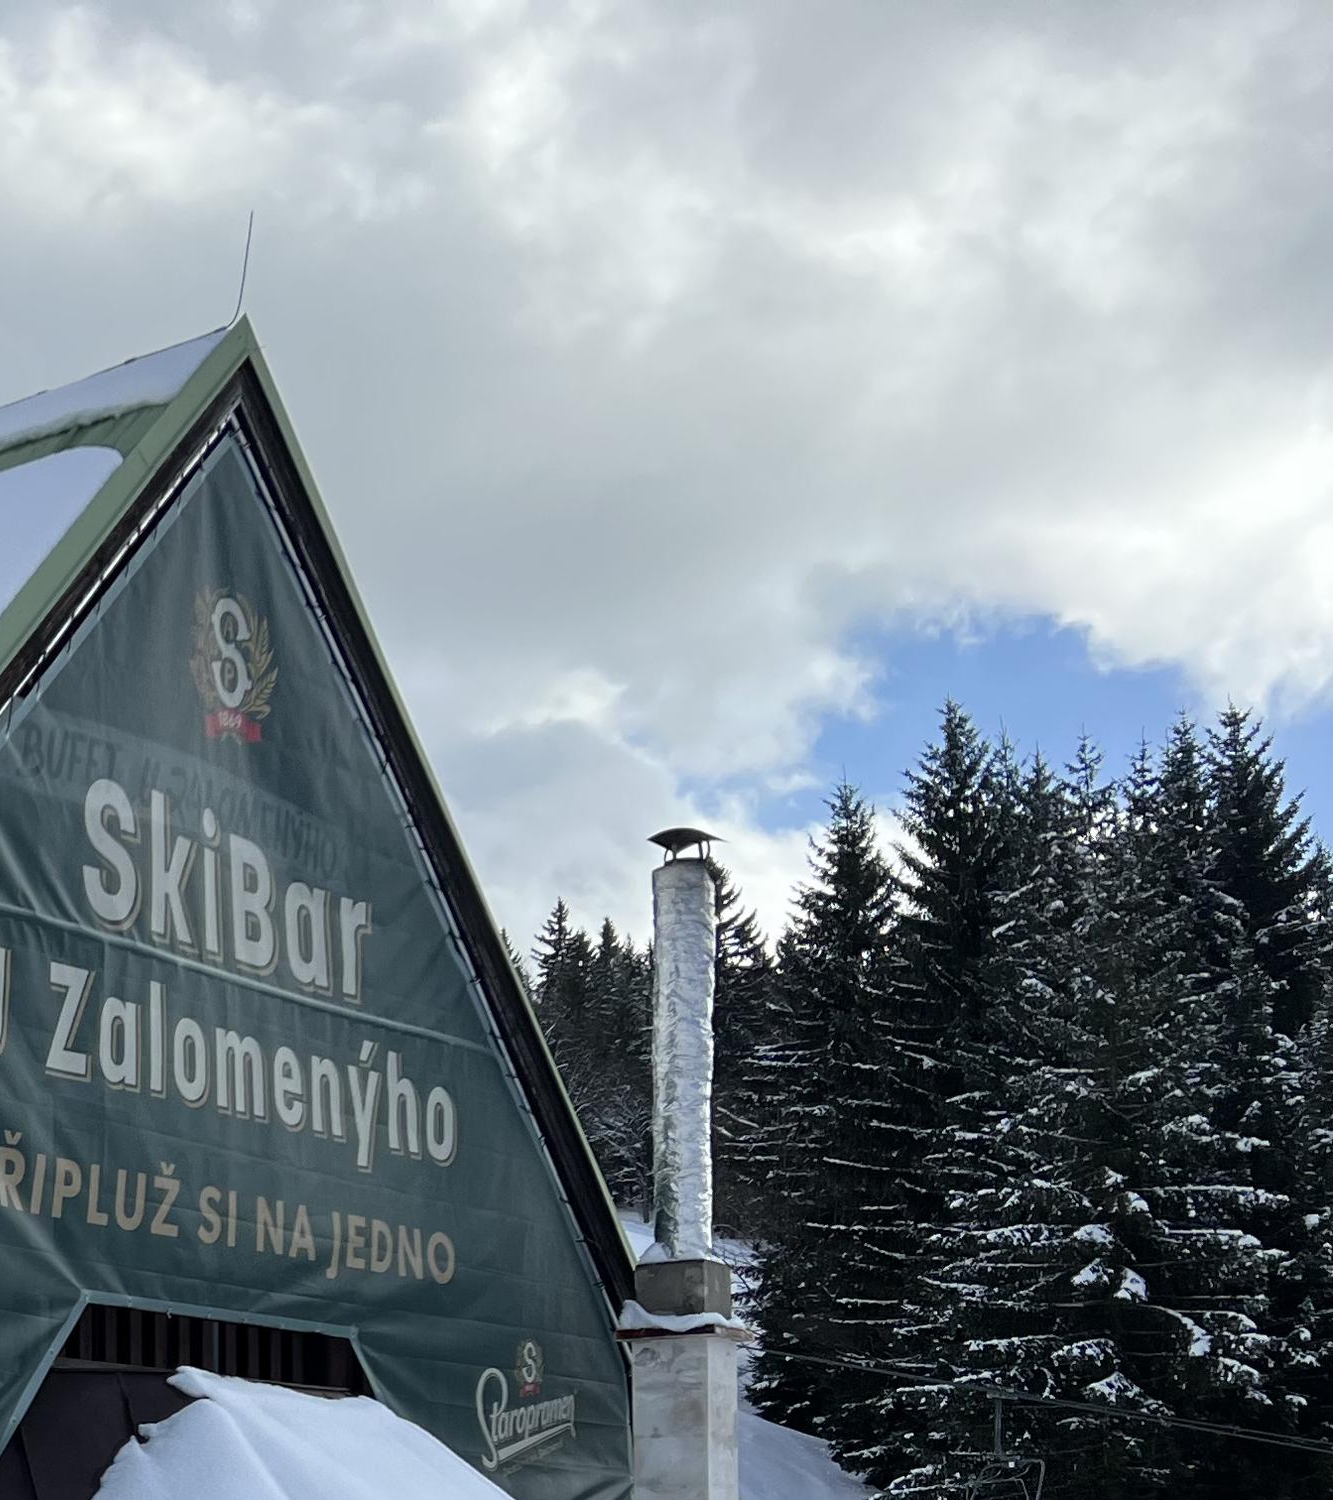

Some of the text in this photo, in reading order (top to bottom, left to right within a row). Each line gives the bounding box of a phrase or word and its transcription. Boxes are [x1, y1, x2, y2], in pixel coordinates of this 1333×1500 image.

[83, 778, 371, 1003] SkiBar
[45, 961, 457, 1173] Zalomenýho
[197, 1186, 237, 1248] SI
[256, 1196, 317, 1262] NA
[326, 1210, 456, 1285] JEDNO
[476, 1367, 576, 1469] Staropramen
